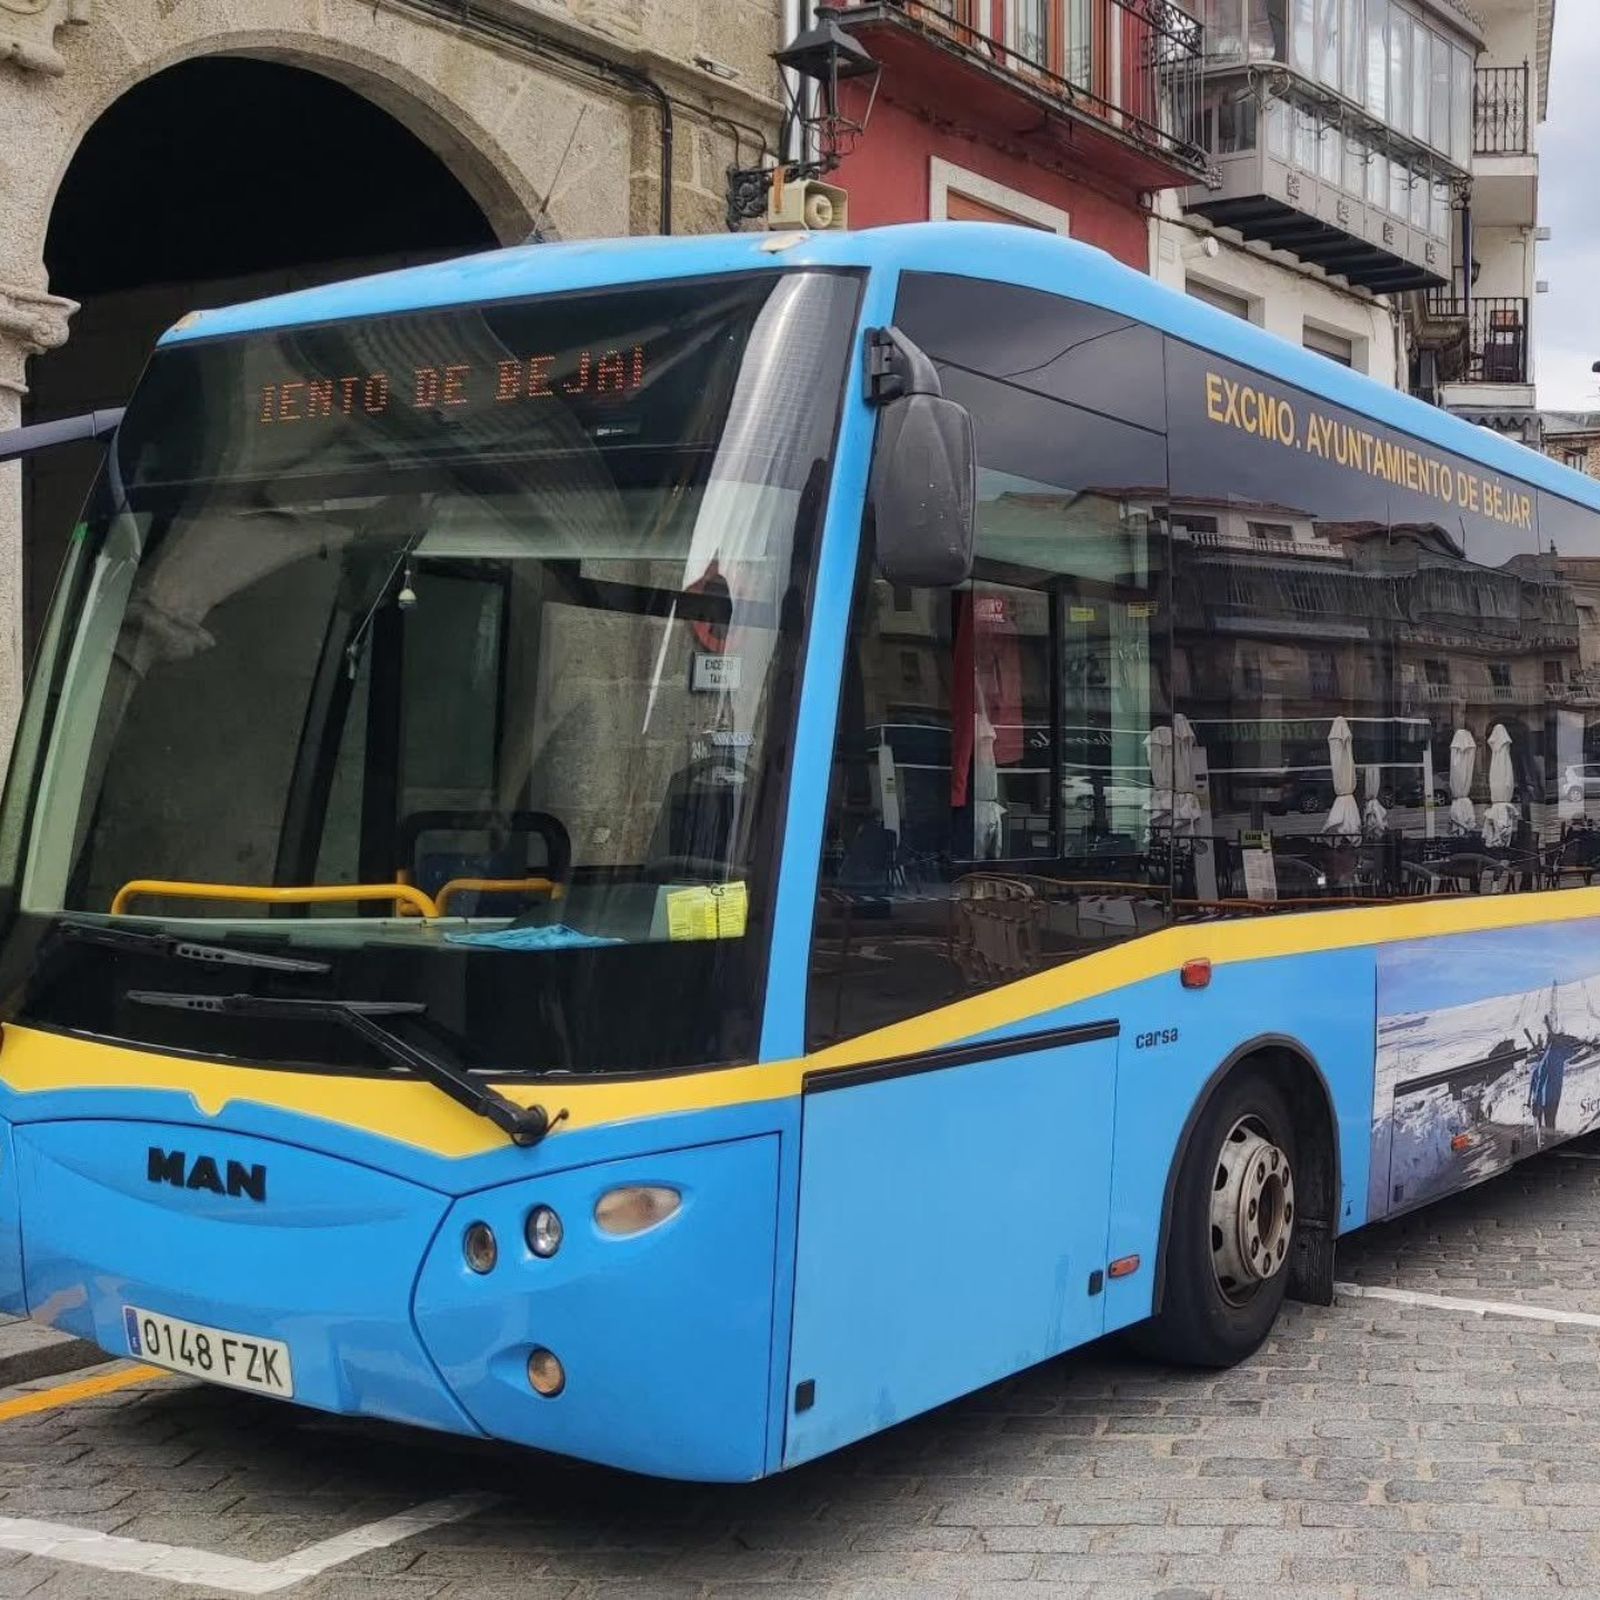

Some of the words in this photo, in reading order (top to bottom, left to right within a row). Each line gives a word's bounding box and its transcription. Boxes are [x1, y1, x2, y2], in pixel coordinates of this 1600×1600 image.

[412, 363, 472, 408] DE
[1205, 371, 1301, 449] EXCMO.
[1306, 412, 1452, 503] AYUNTAMIENTO
[1456, 470, 1479, 513] DE
[1482, 477, 1533, 530] BÉJAR
[1135, 1027, 1179, 1050] carsa
[147, 1146, 267, 1204] MAN
[143, 1318, 214, 1372] 0148
[221, 1337, 285, 1389] FZK
